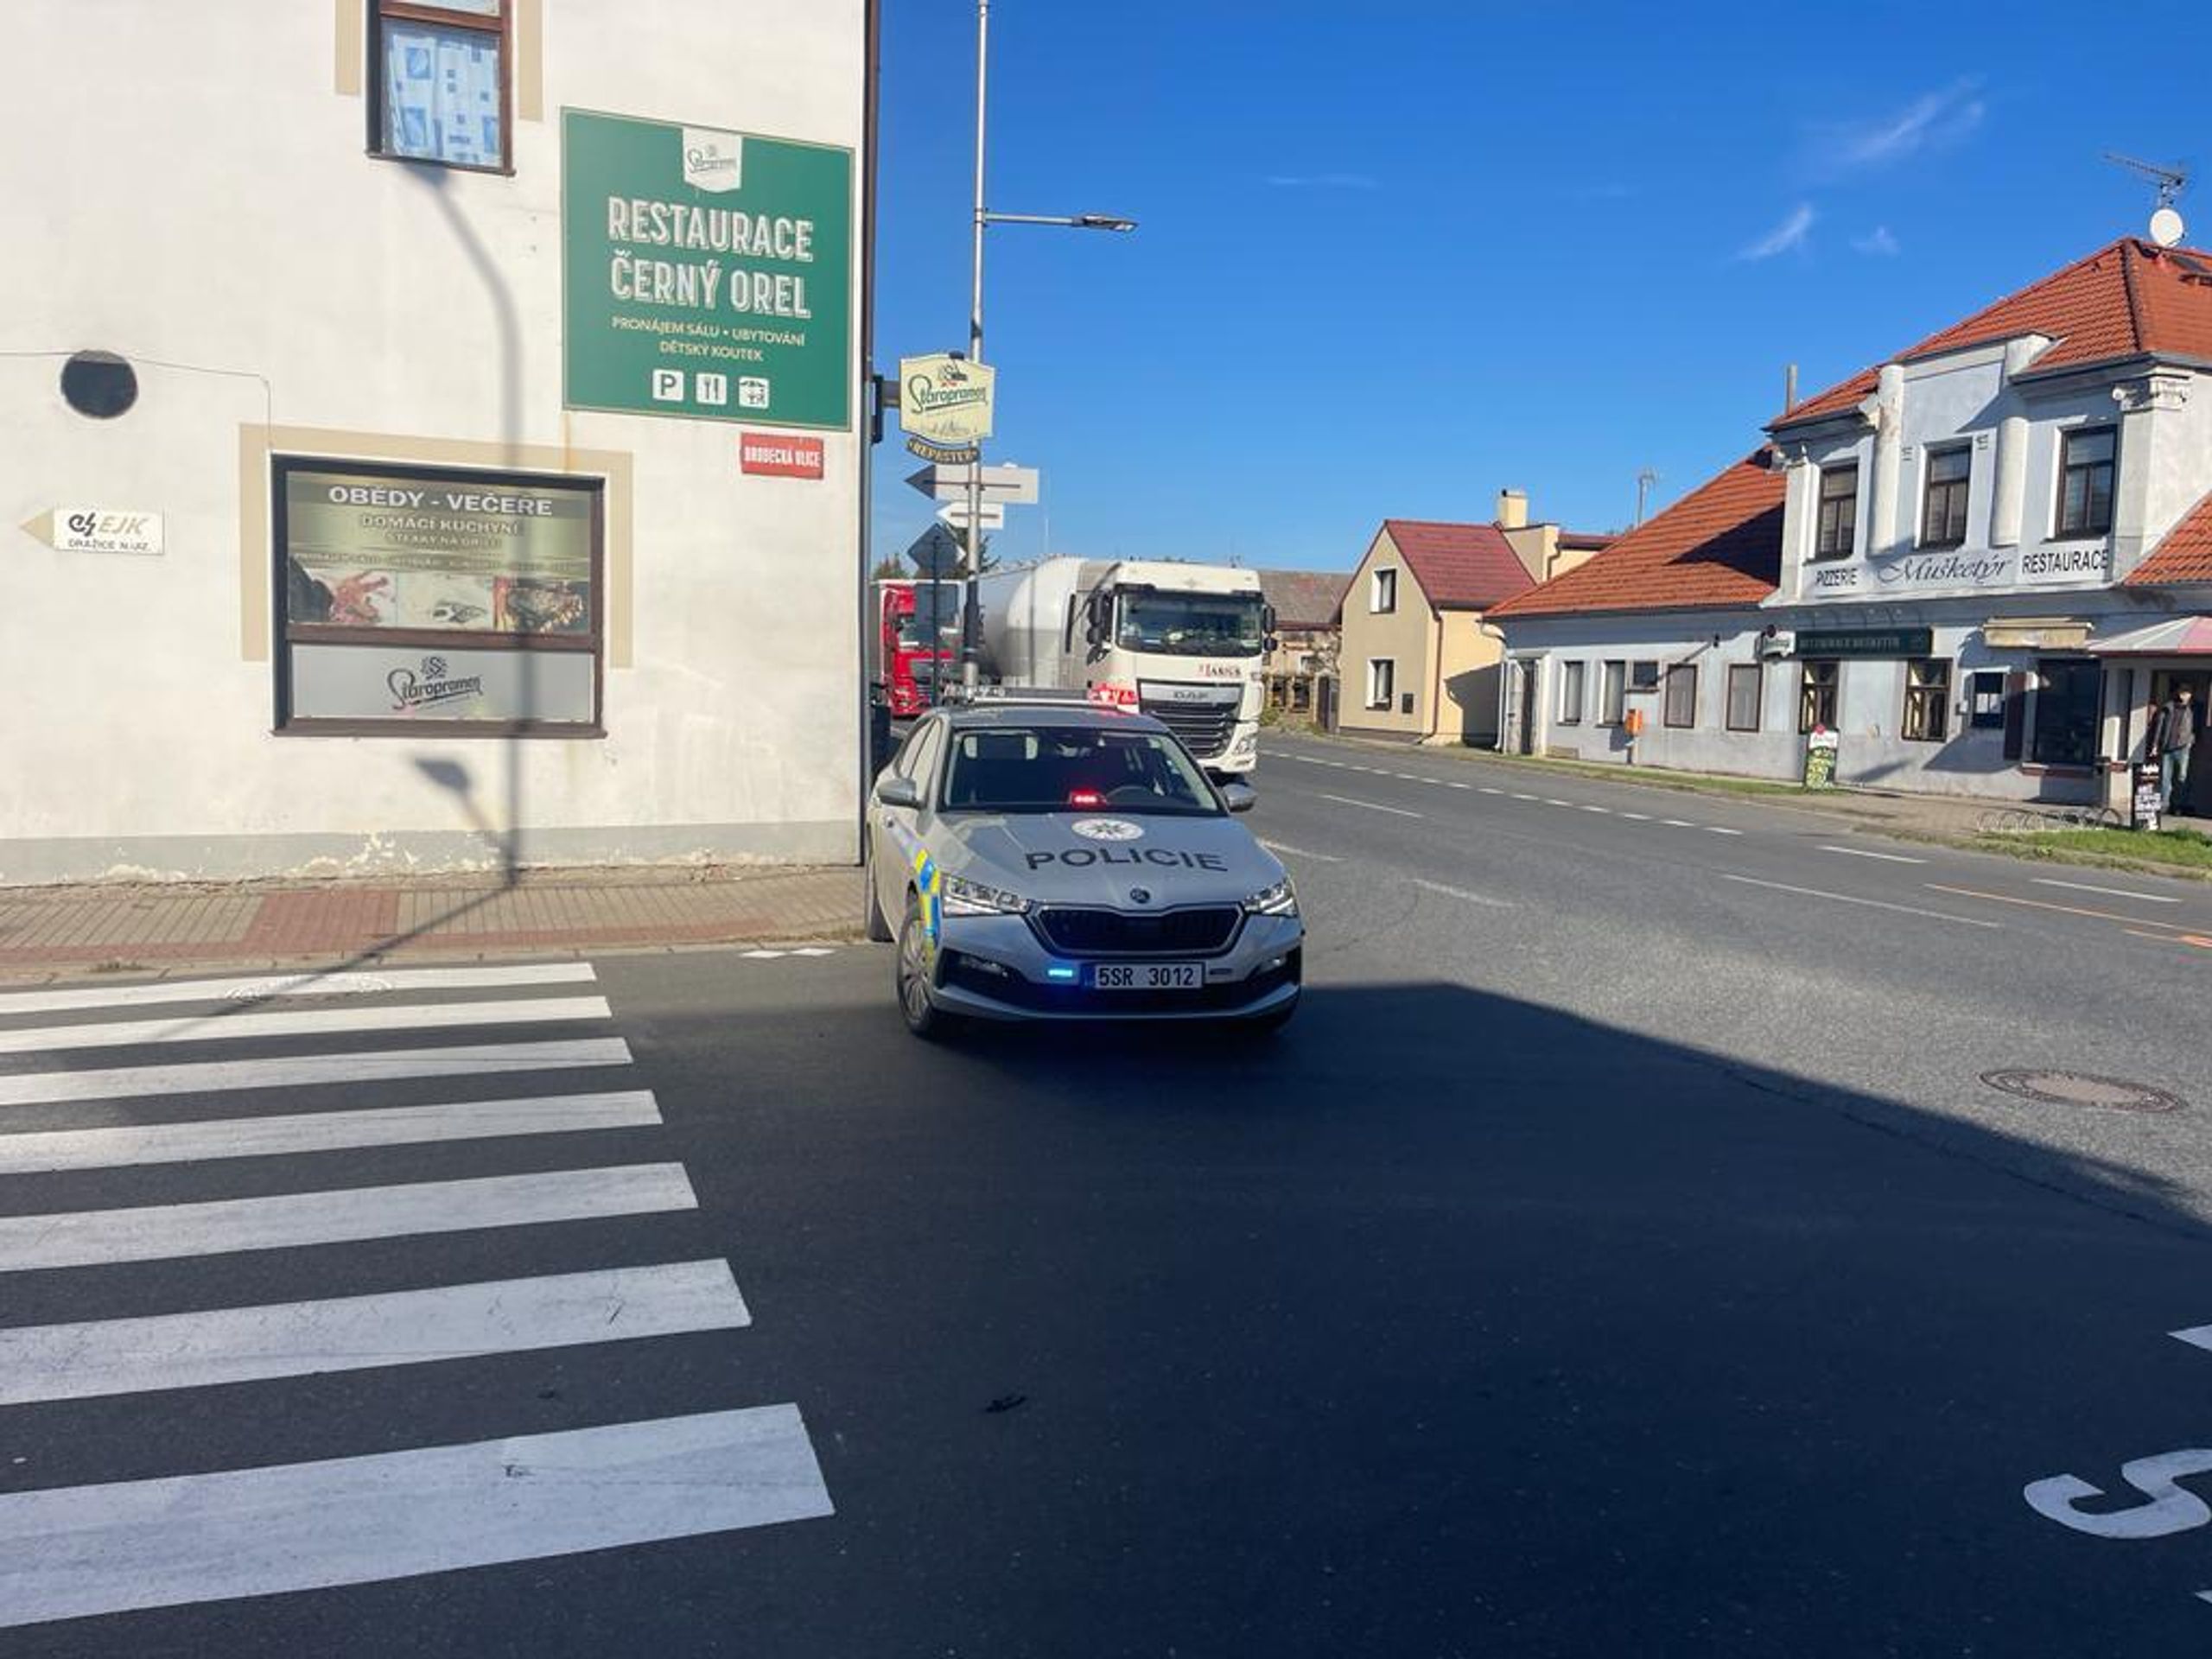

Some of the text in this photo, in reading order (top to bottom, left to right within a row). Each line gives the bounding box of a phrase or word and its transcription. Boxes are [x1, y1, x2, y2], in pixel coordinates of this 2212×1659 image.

[607, 195, 815, 264] RESTAURACE
[610, 247, 812, 320] ČERNÝ OREL
[611, 316, 805, 347] PRONÁJEM SÁLU UBYTOVÁNÍ
[710, 344, 765, 363] KOUTEK
[1815, 567, 1858, 588] PIZZERIE
[2021, 548, 2110, 575] RESTAURACE
[387, 669, 483, 710] Staropramen
[1025, 848, 1228, 873] POLICIE
[1098, 967, 1194, 987] 5SR 3012
